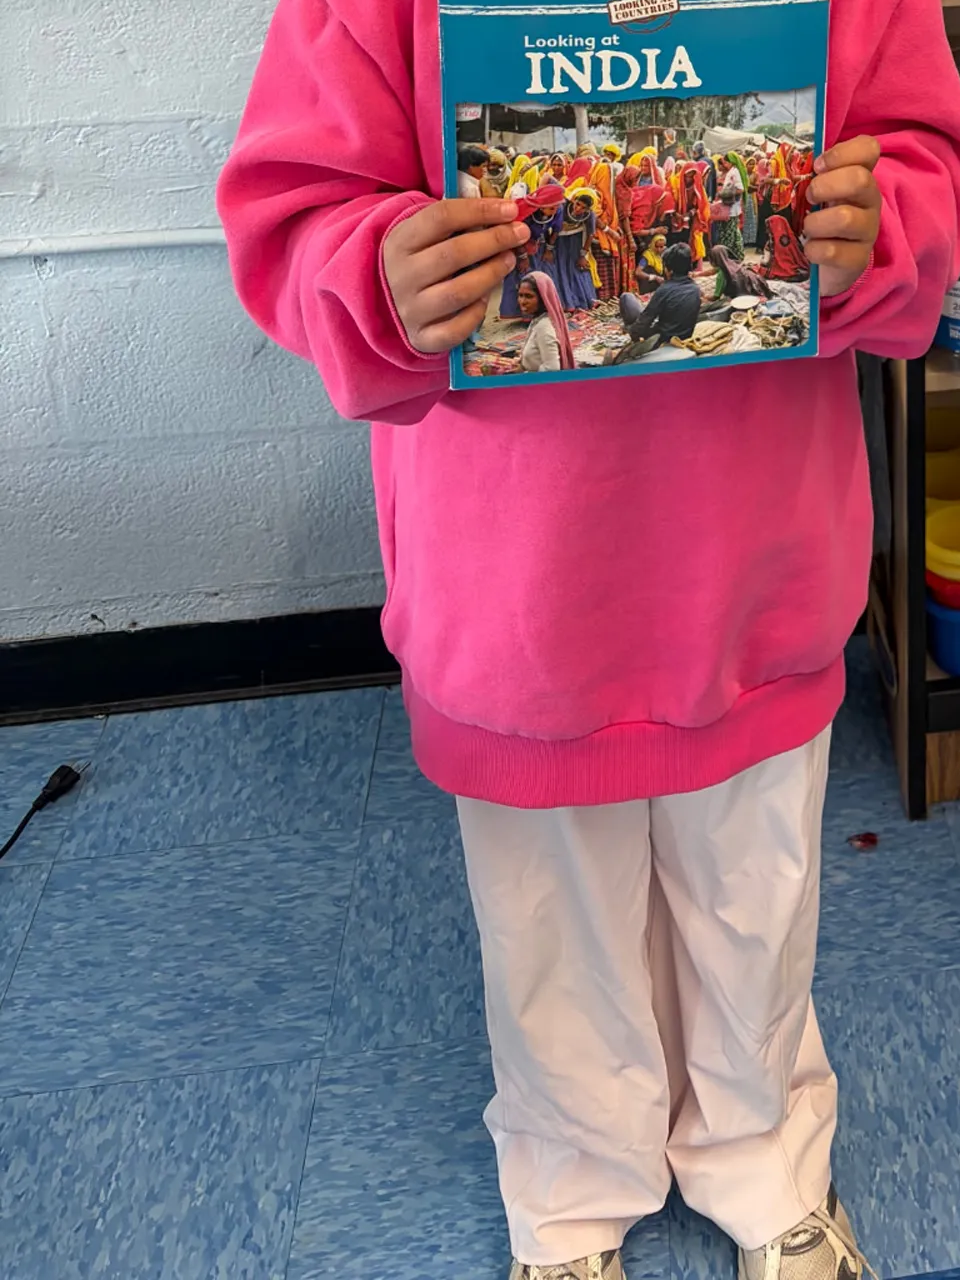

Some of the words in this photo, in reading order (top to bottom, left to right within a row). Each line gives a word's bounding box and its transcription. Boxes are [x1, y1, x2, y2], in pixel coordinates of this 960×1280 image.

[615, 2, 675, 20] COUNTRIES
[524, 34, 596, 50] Looking
[601, 33, 620, 46] at
[525, 45, 703, 95] INDIA
